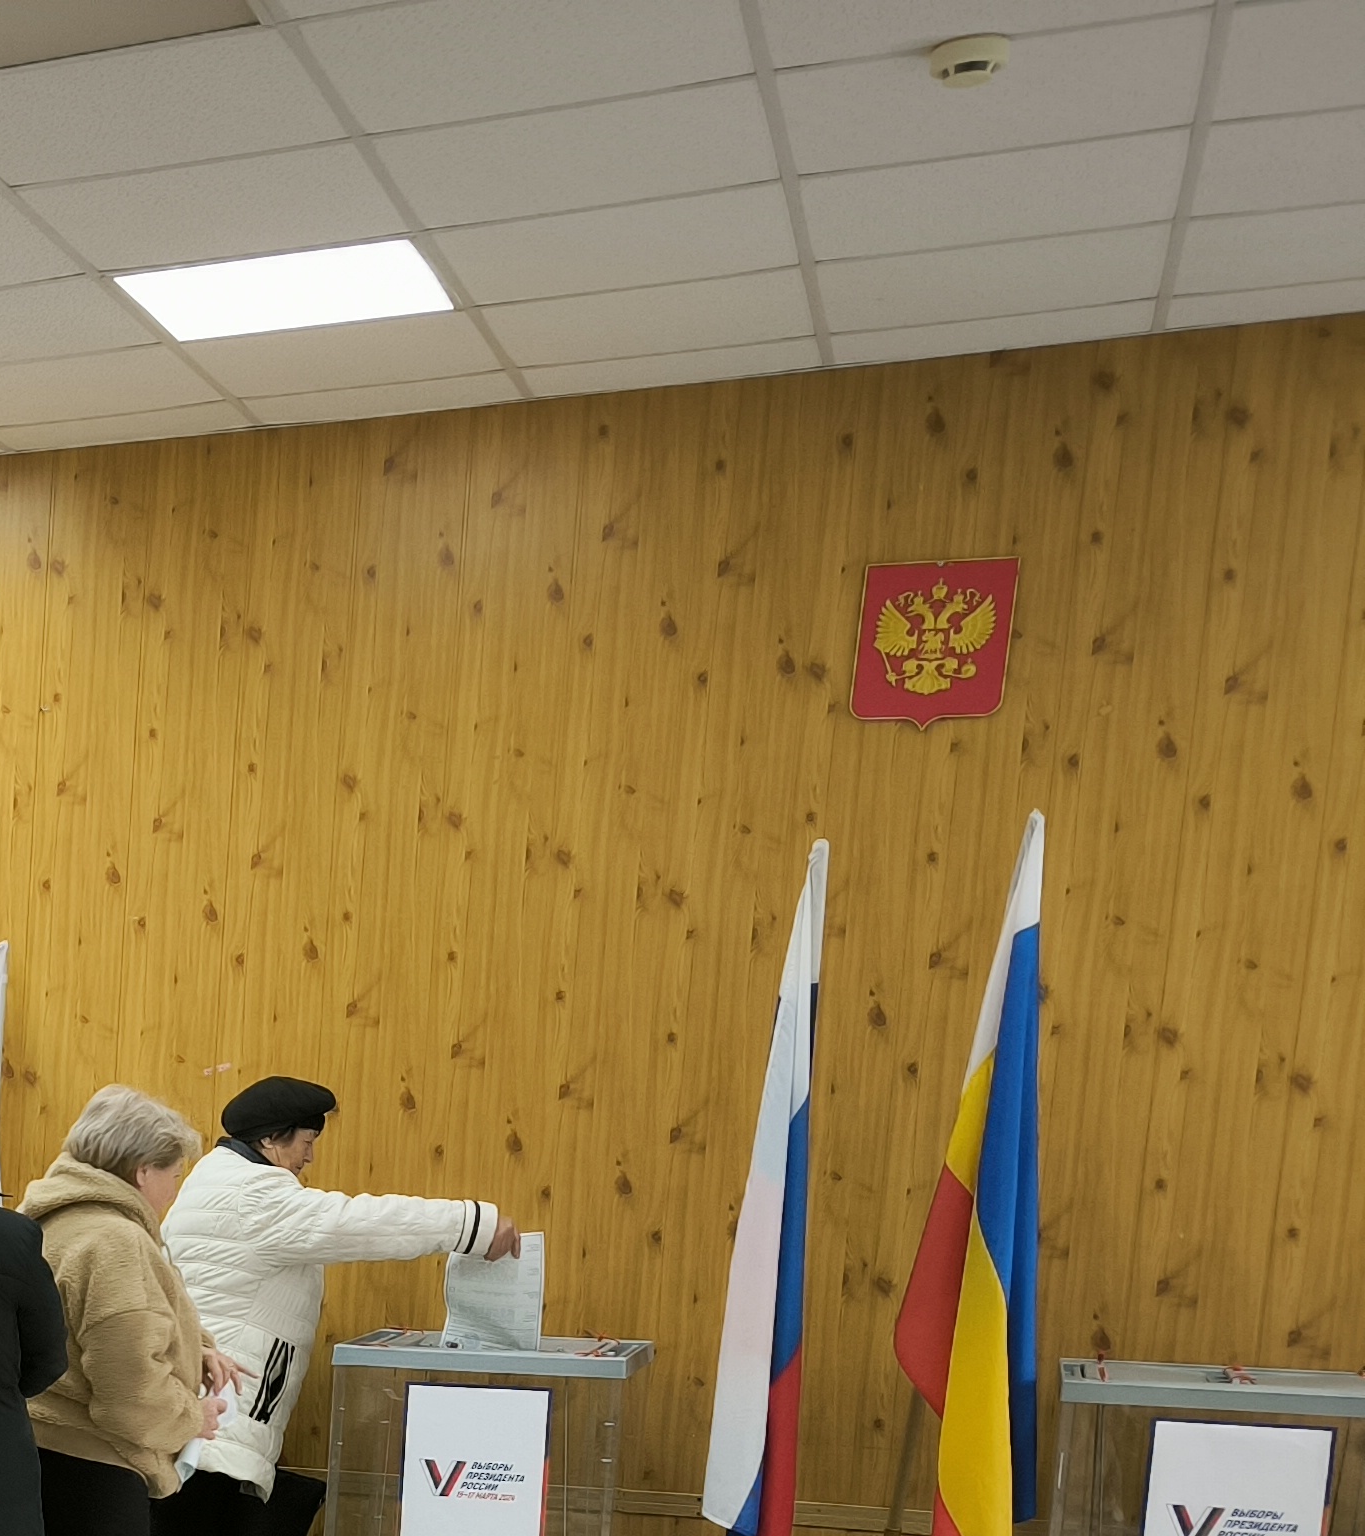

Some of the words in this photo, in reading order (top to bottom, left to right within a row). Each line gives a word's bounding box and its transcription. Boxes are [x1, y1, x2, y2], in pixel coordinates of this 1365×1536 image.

[471, 1462, 514, 1471] ВЫБОРЫ
[465, 1472, 526, 1483] ПРЕЗИДЕНТА
[460, 1482, 499, 1491] РОССИИ
[1231, 1508, 1285, 1520] ВЫБОРЫ
[1223, 1520, 1299, 1533] ПРЕЗИДЕНТА
